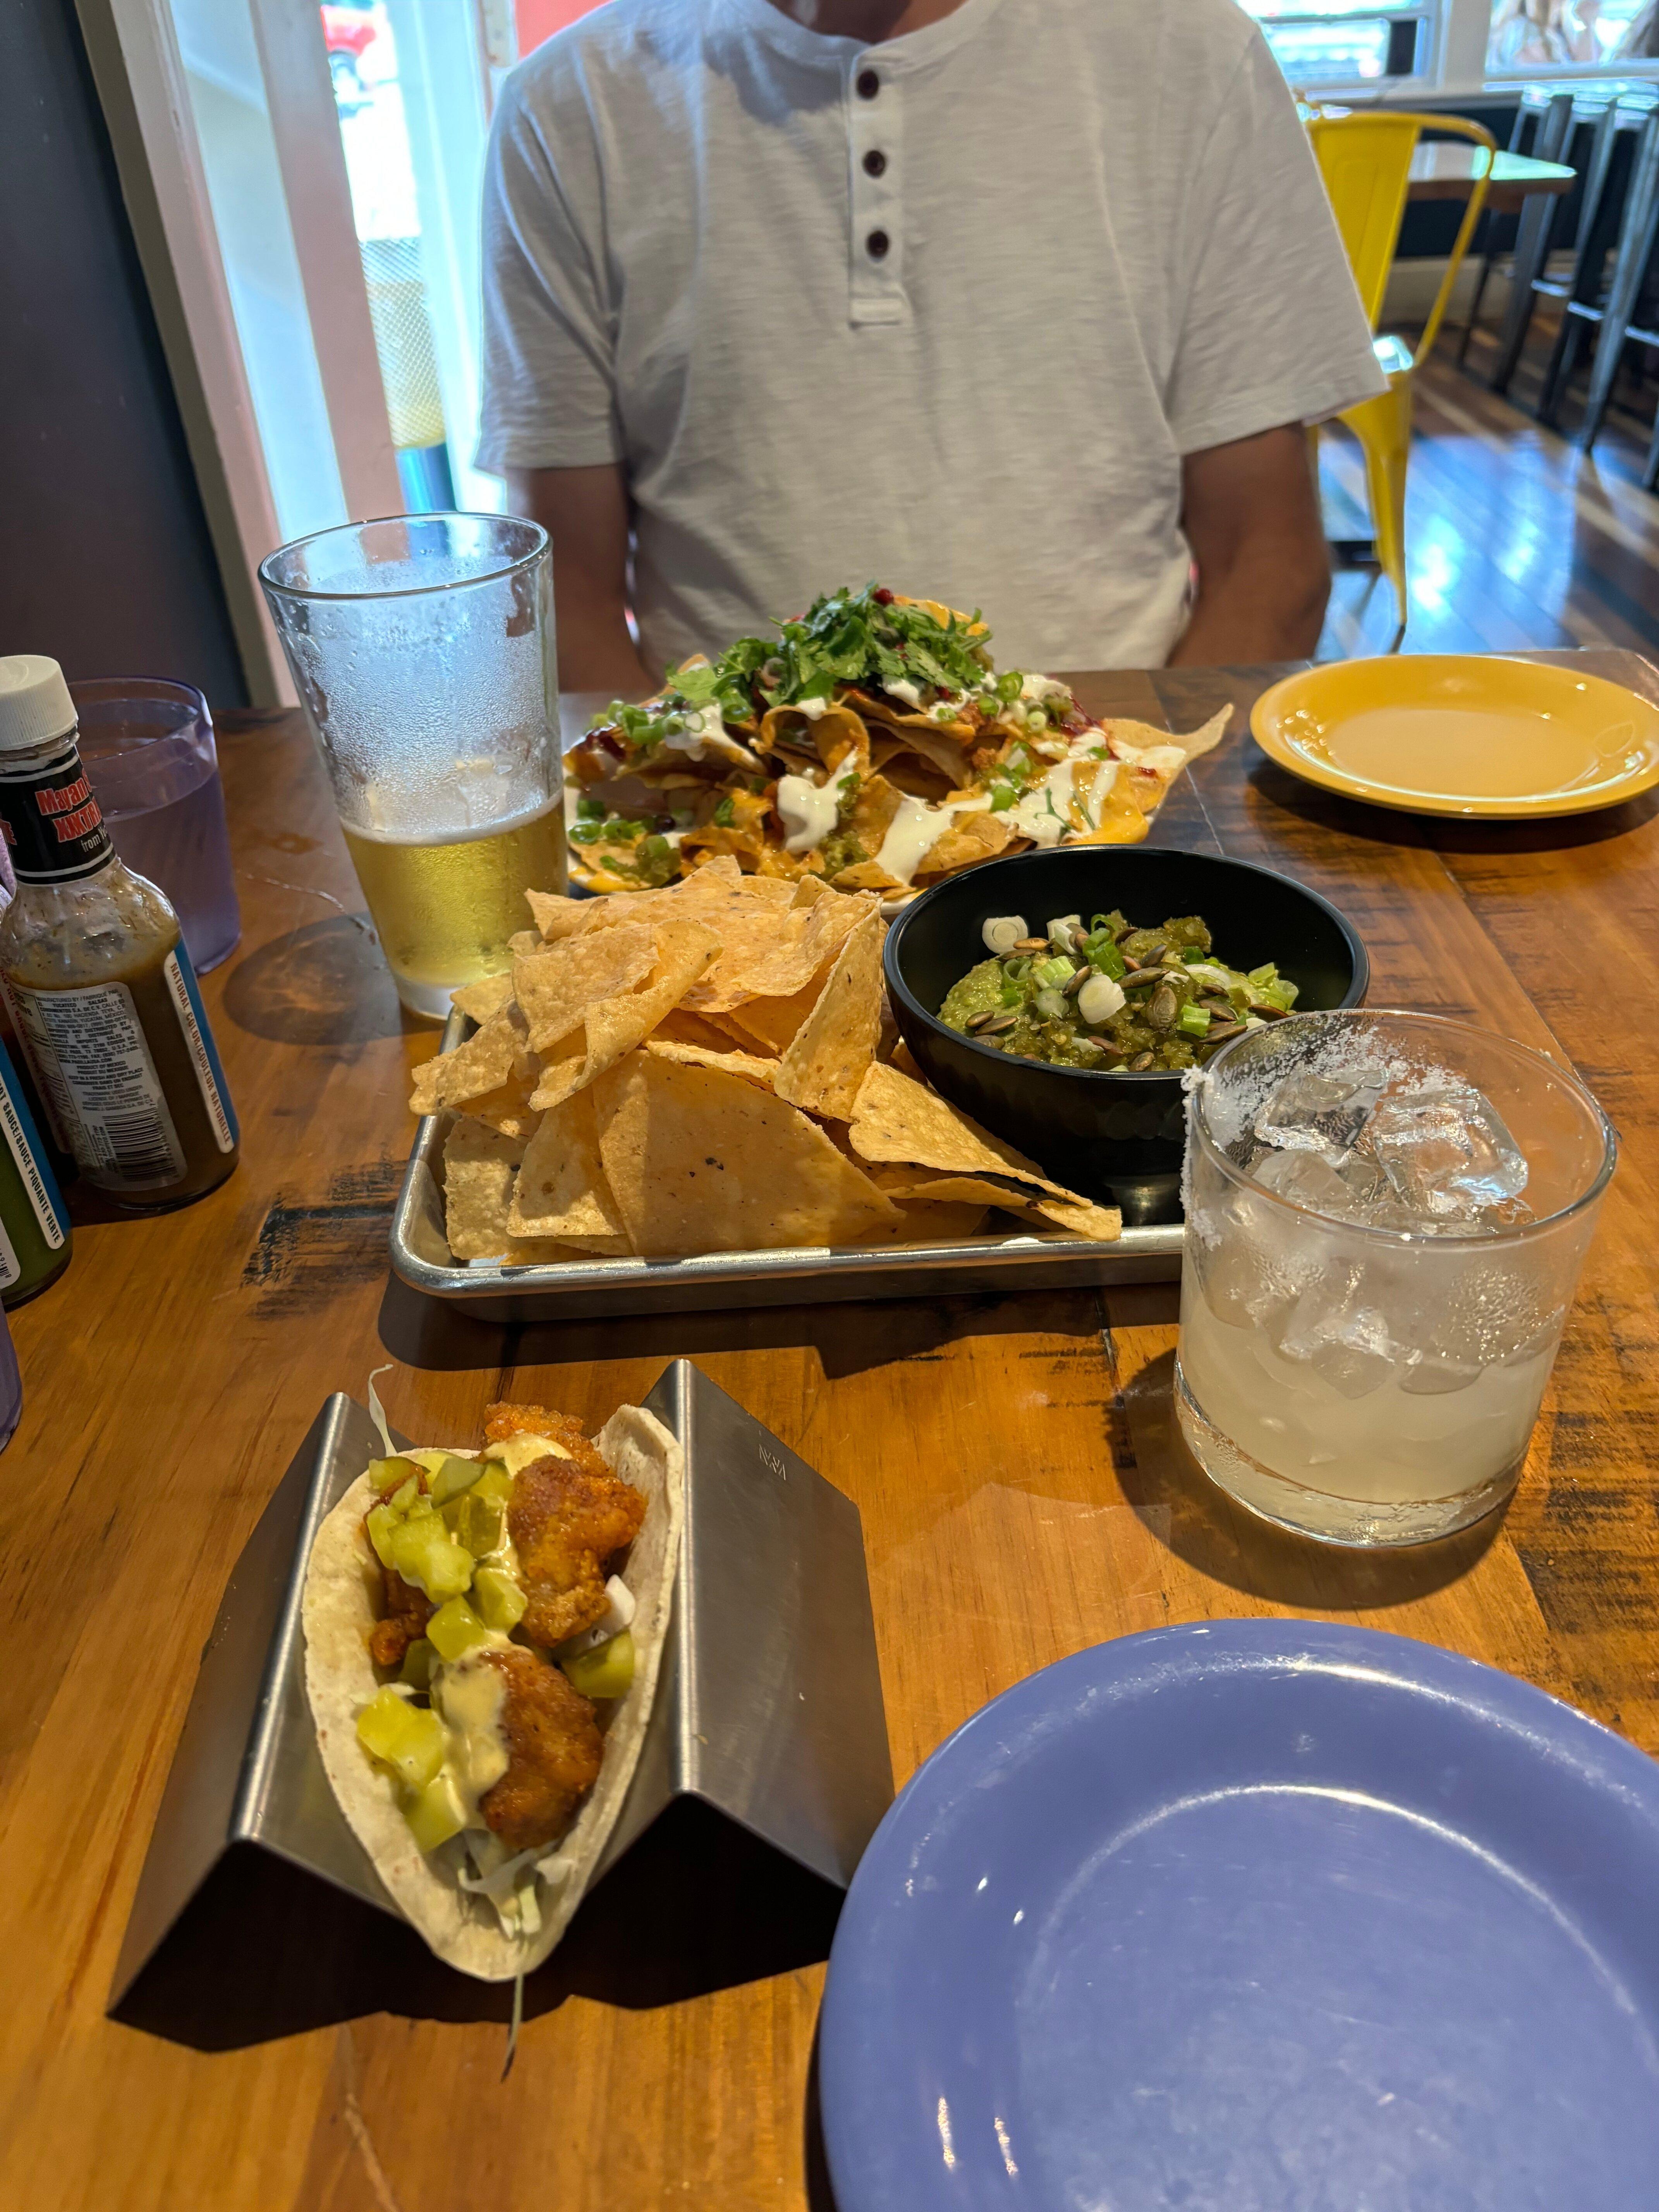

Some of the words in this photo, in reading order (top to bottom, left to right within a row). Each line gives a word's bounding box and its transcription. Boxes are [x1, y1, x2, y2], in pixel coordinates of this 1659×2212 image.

[34, 777, 89, 816] Mayan
[81, 834, 101, 852] from
[170, 962, 190, 1010] NATURAL
[211, 1091, 230, 1144] NATURELLE
[3, 1102, 32, 1168] SAUCE/SAUCE
[28, 1167, 49, 1214] PIQUANTE
[45, 1213, 61, 1243] VERTE
